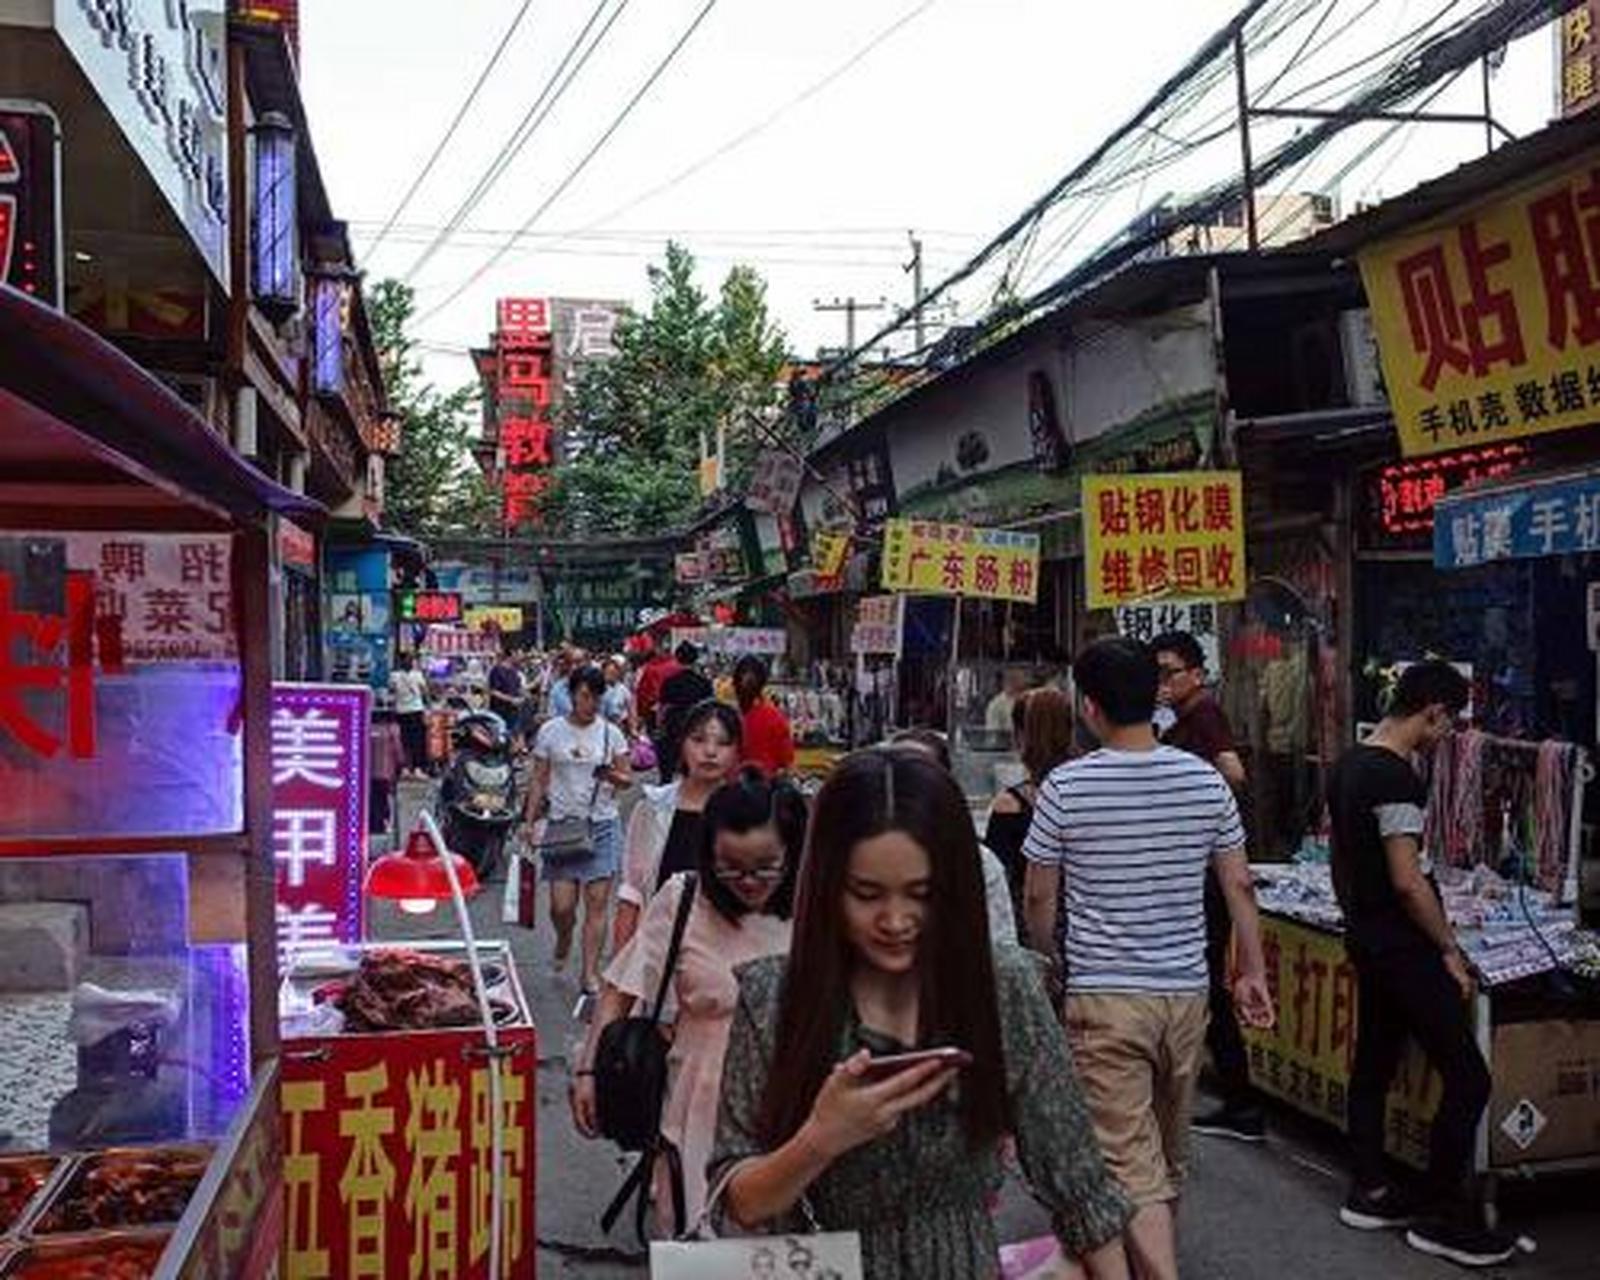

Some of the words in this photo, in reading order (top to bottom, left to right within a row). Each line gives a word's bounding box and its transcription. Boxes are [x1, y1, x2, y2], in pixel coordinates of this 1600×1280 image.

[1420, 392, 1510, 443] 手机壳
[1099, 483, 1233, 536] 贴钢化膜
[908, 549, 1031, 596] 广东肠粉
[1101, 544, 1234, 597] 维修回收
[280, 1058, 525, 1280] 五香猪蹄
